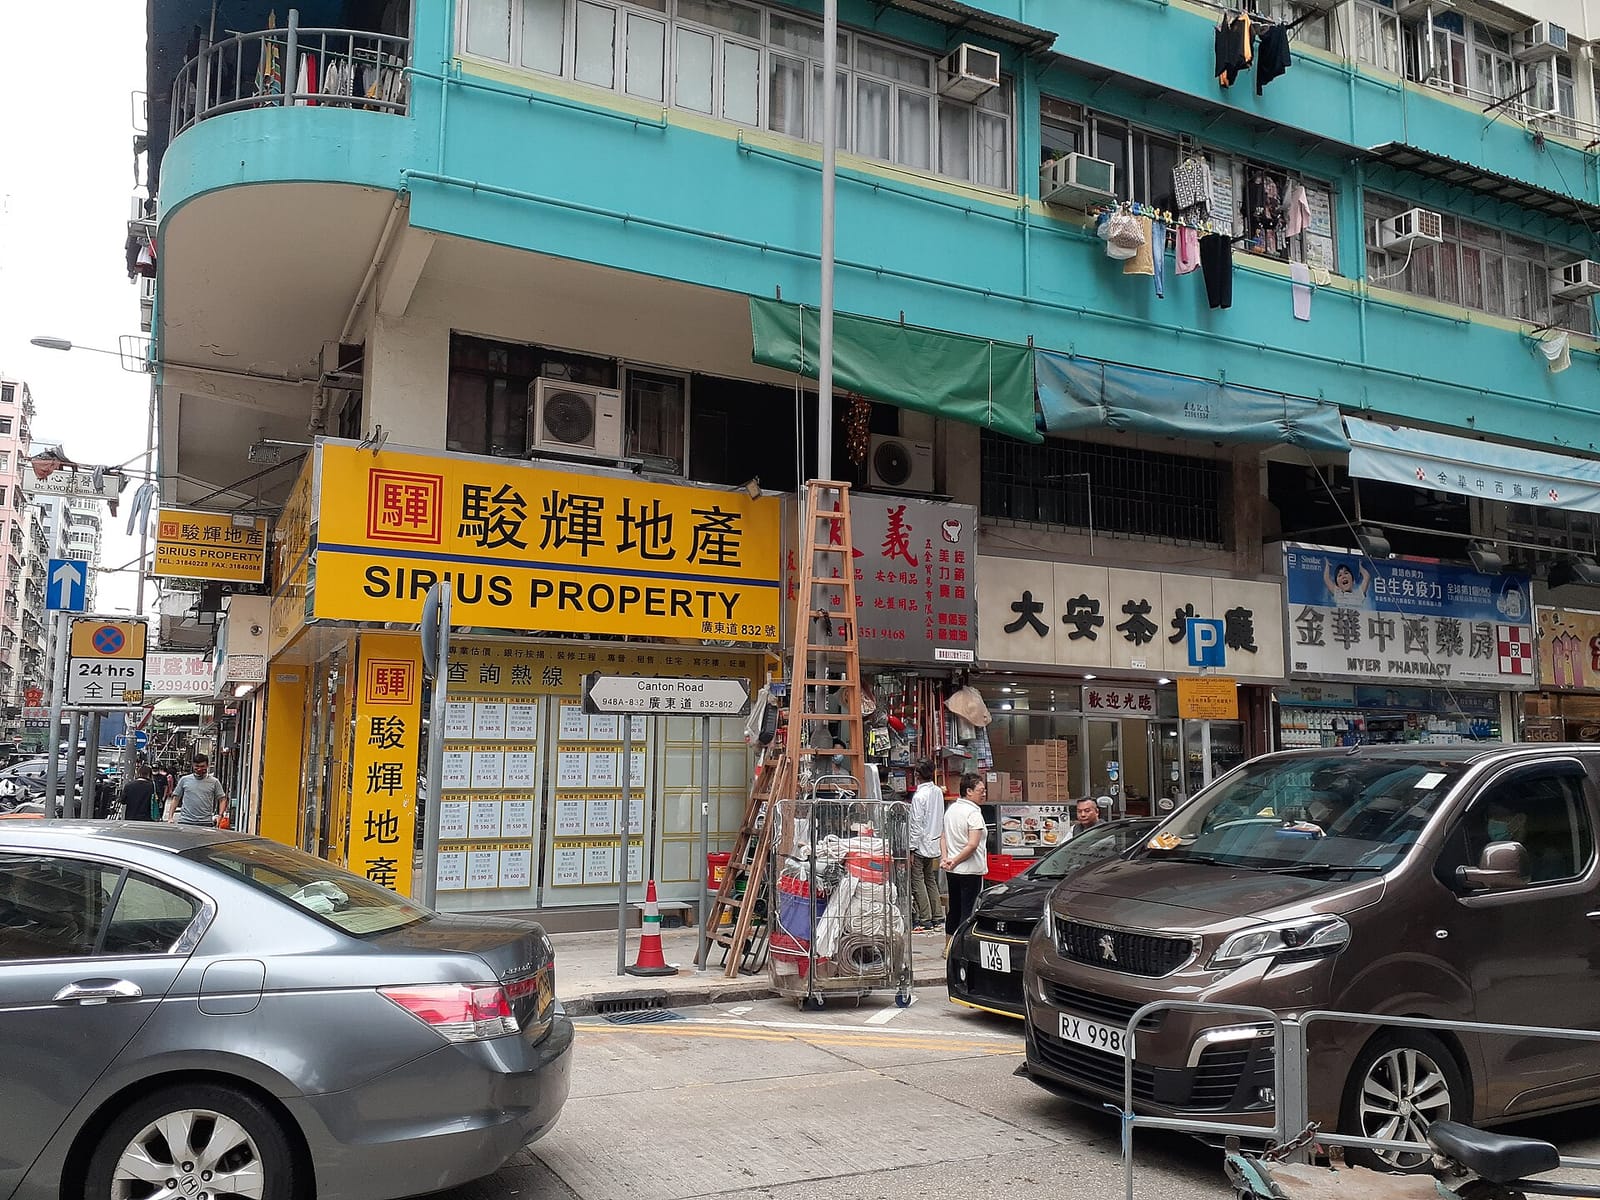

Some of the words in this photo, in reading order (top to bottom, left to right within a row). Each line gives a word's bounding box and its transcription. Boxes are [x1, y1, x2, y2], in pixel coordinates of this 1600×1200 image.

[181, 524, 263, 546] 駿輝地產
[457, 483, 743, 568] 駿輝地產
[158, 546, 196, 557] SIRIUS
[200, 550, 261, 562] PROPERTY
[875, 569, 918, 585] 安全用品
[954, 550, 965, 599] 經銷商
[923, 538, 934, 641] 五金貿易有限公司
[1374, 577, 1442, 599] 自生免疫力
[530, 579, 740, 620] PROPERTY
[701, 621, 738, 635] 廣東道
[741, 624, 761, 635] 832
[765, 624, 776, 637] 號
[880, 627, 906, 640] 9168
[1295, 606, 1495, 659] 金華中西藥房
[1194, 622, 1217, 661] P
[79, 664, 102, 676] 24
[108, 664, 135, 677] hrs
[1347, 657, 1381, 673] MYER
[1388, 660, 1452, 677] PHARMACY
[84, 681, 127, 699] 全日
[637, 681, 674, 691] Canton
[677, 682, 704, 692] Road
[648, 698, 692, 709] 廣東道
[699, 700, 733, 708] 832-802
[363, 715, 406, 891] 駿輝地產
[987, 943, 1001, 956] VK
[987, 958, 1003, 970] 149
[1062, 1016, 1080, 1039] RX
